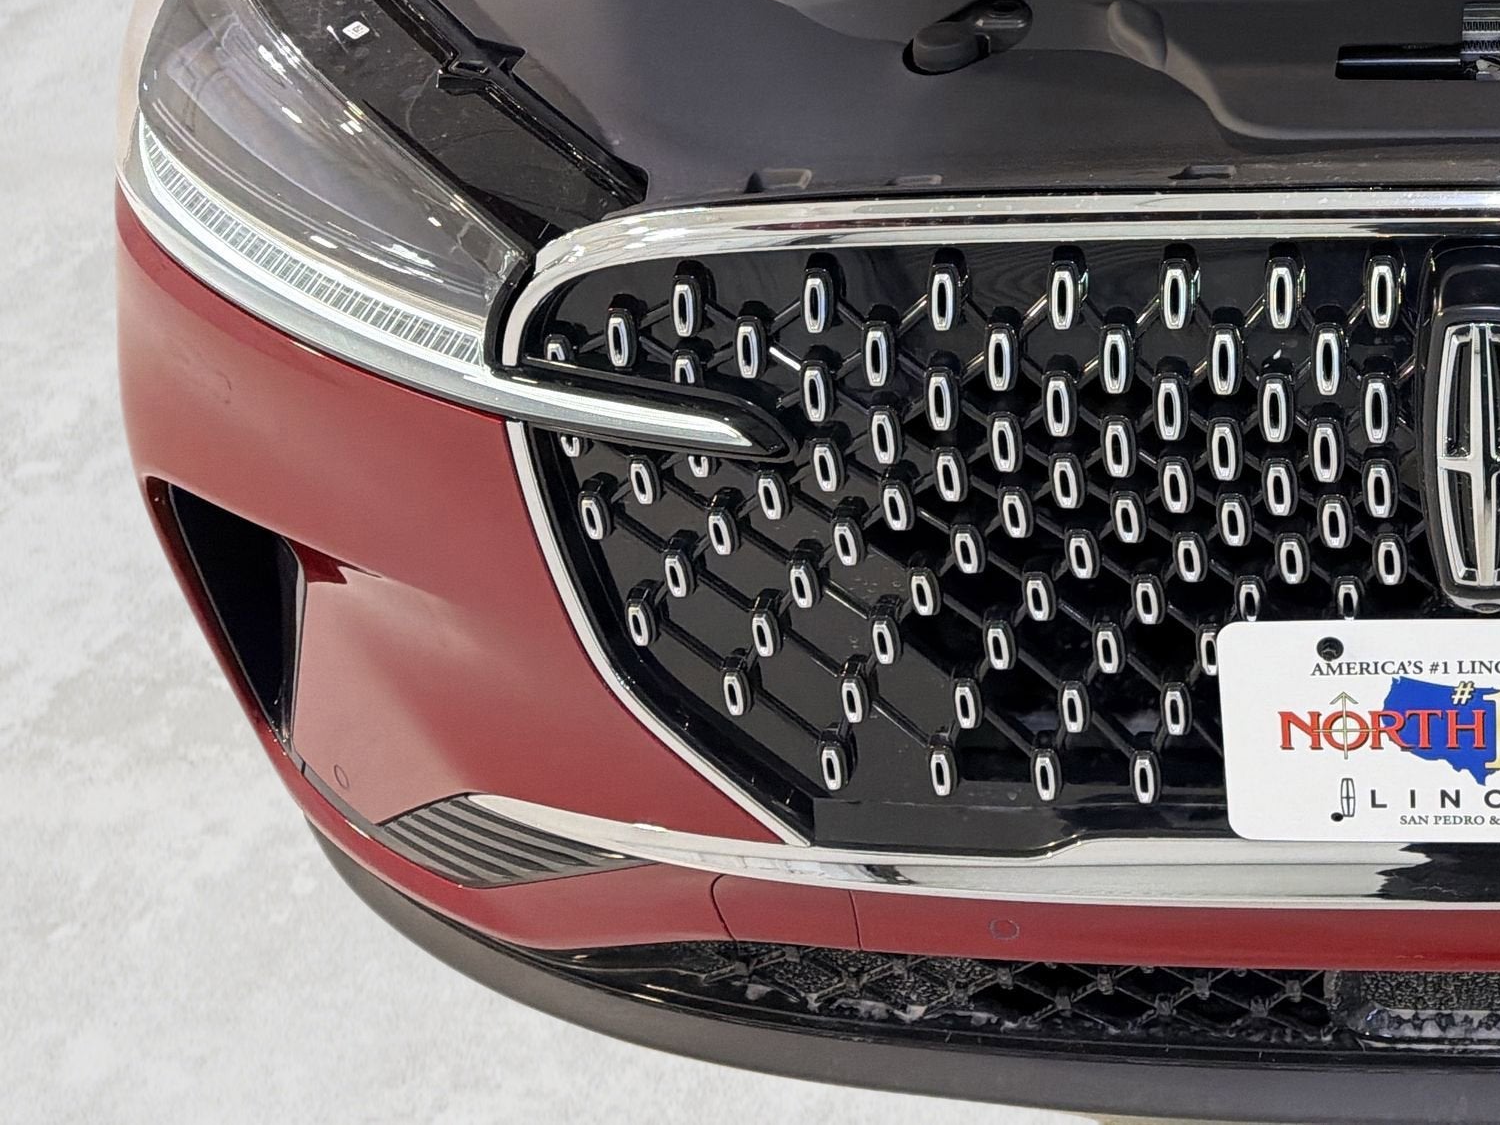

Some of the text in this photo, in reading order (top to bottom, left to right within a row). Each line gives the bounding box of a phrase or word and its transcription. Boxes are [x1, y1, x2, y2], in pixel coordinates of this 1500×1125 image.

[1310, 660, 1423, 676] AMERICA'S
[1429, 660, 1450, 675] #1
[1278, 708, 1486, 752] NORTH
[1399, 814, 1430, 825] SAN
[1433, 814, 1485, 826] PEDRO
[1488, 815, 1500, 826] &
